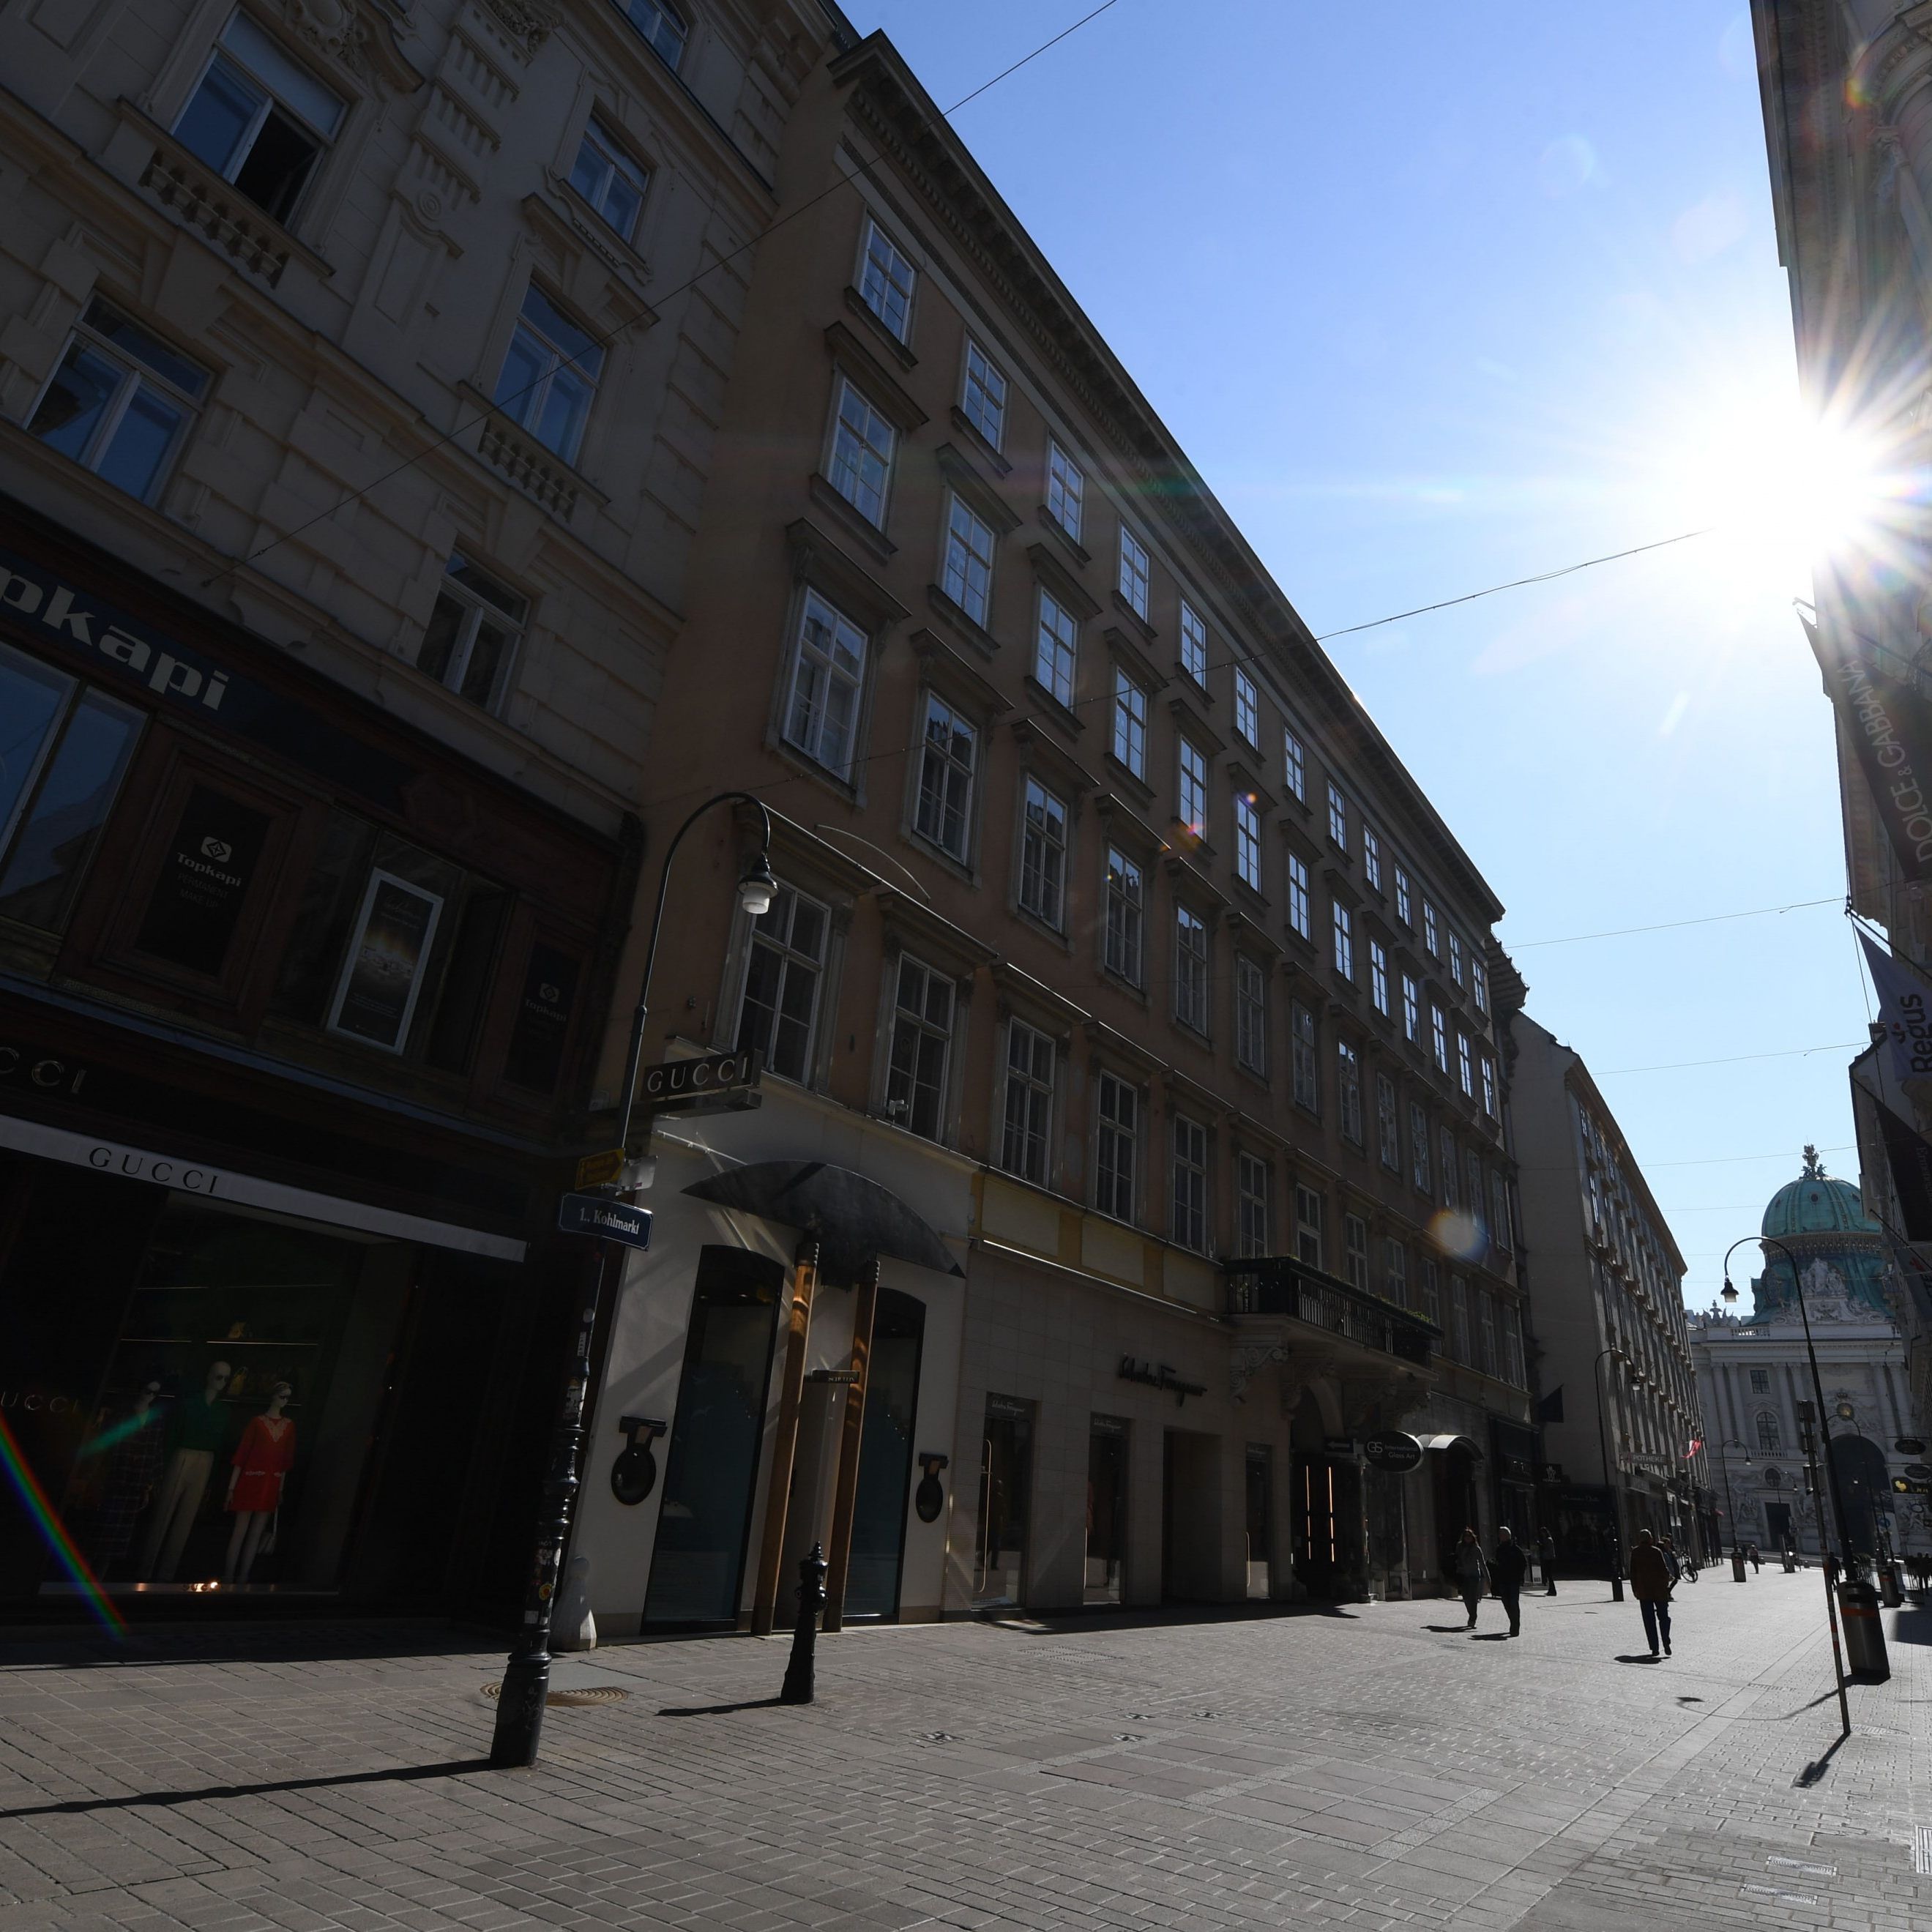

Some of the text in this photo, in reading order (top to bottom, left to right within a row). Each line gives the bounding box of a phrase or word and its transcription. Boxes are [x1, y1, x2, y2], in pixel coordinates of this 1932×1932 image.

[1836, 660, 1906, 769] GABBANA
[1897, 764, 1913, 777] &
[177, 852, 242, 887] Topkapi
[523, 996, 567, 1022] Topkapi
[646, 1056, 749, 1093] GUCCI
[89, 1146, 218, 1193] GUCCI
[594, 1209, 641, 1235] Kohlmarkt
